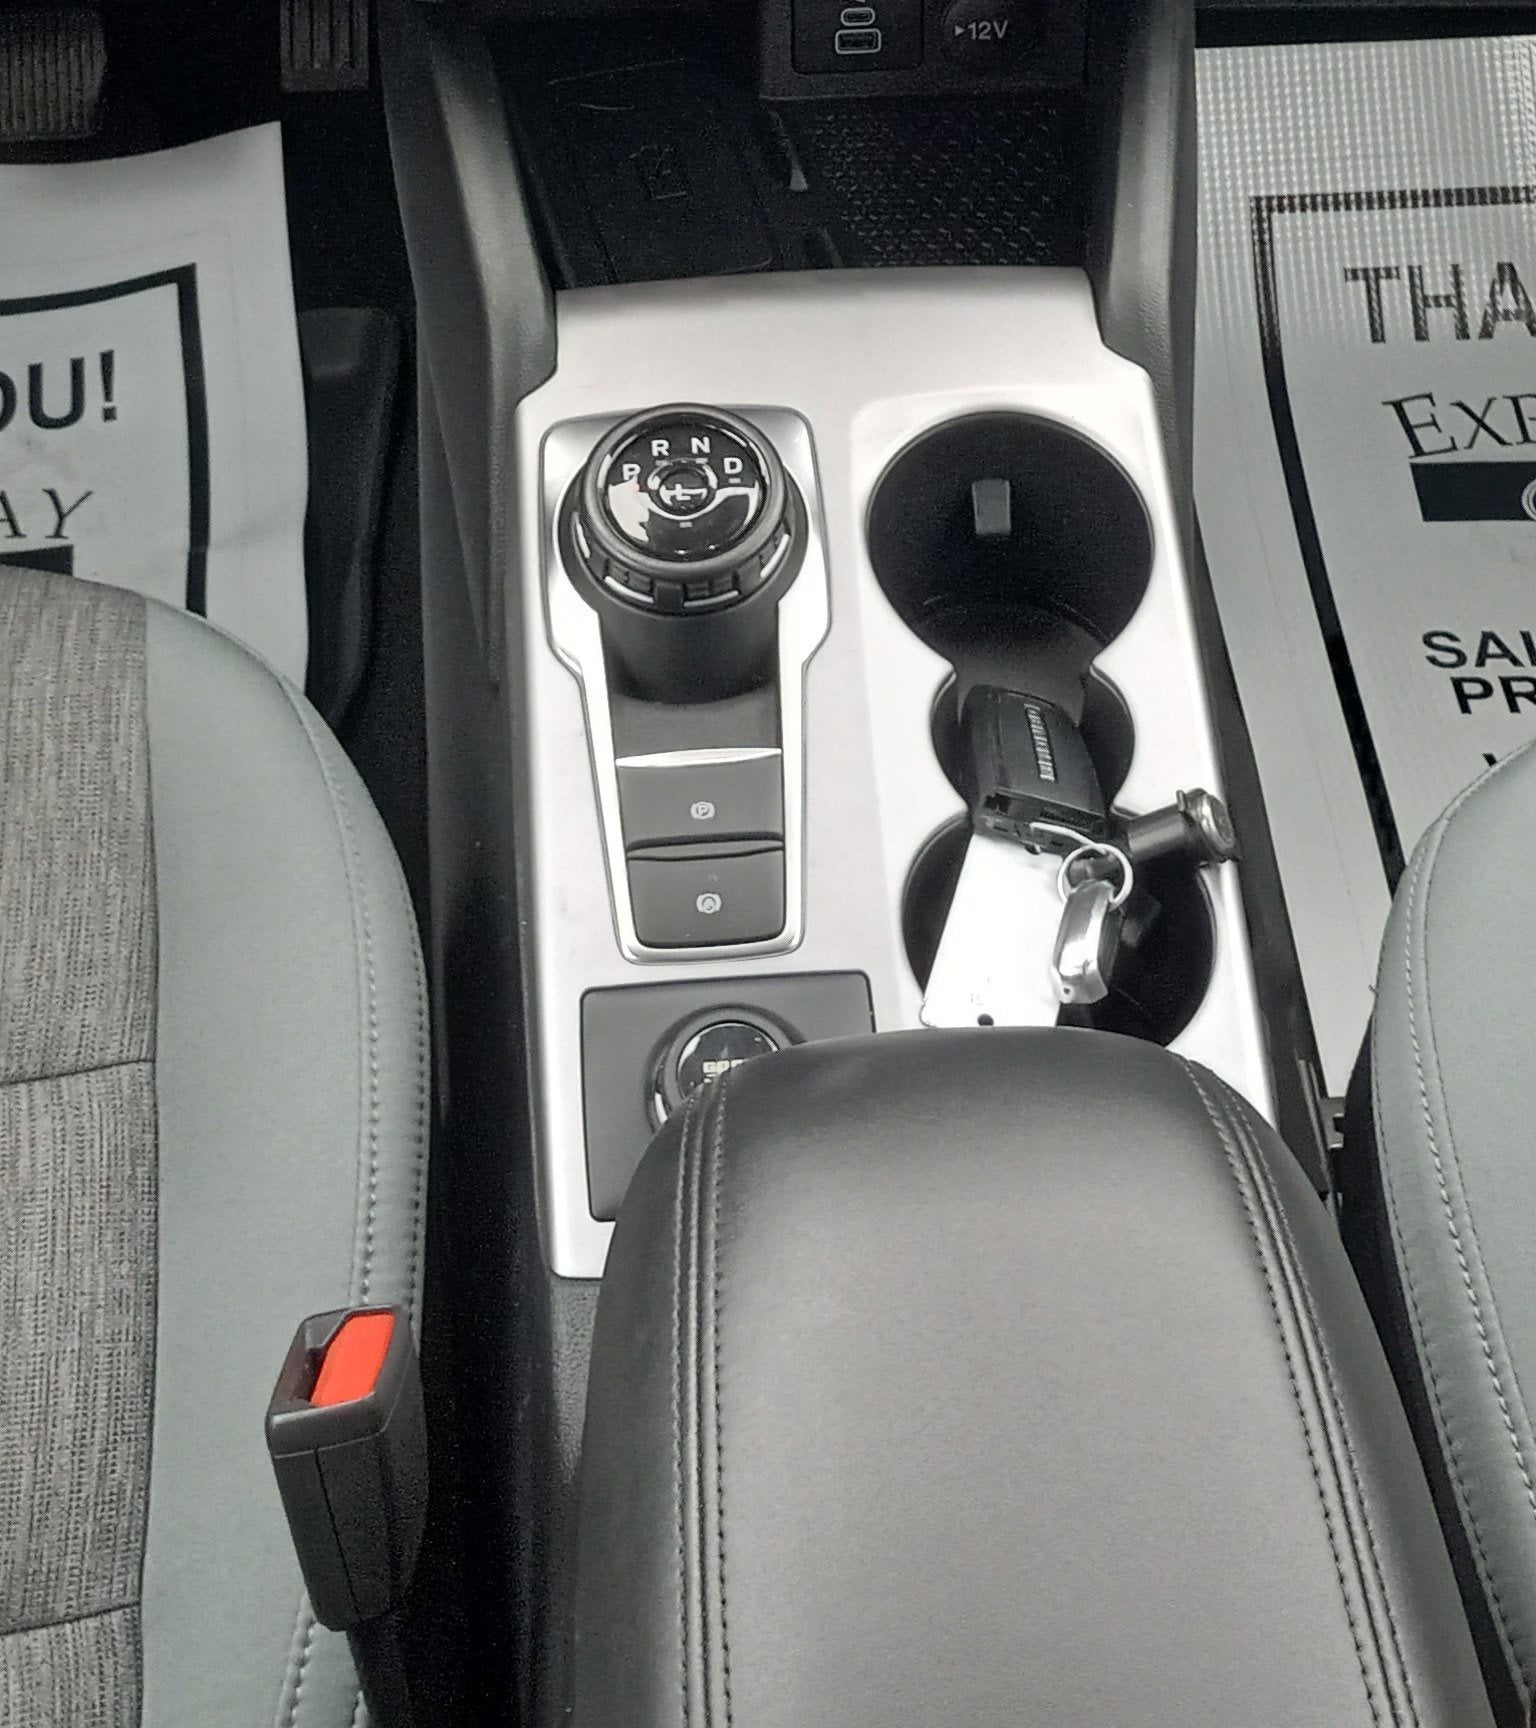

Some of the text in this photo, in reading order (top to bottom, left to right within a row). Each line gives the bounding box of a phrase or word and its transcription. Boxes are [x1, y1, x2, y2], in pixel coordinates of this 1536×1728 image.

[967, 21, 1008, 40] 12V
[651, 436, 711, 457] R N
[723, 457, 743, 475] D
